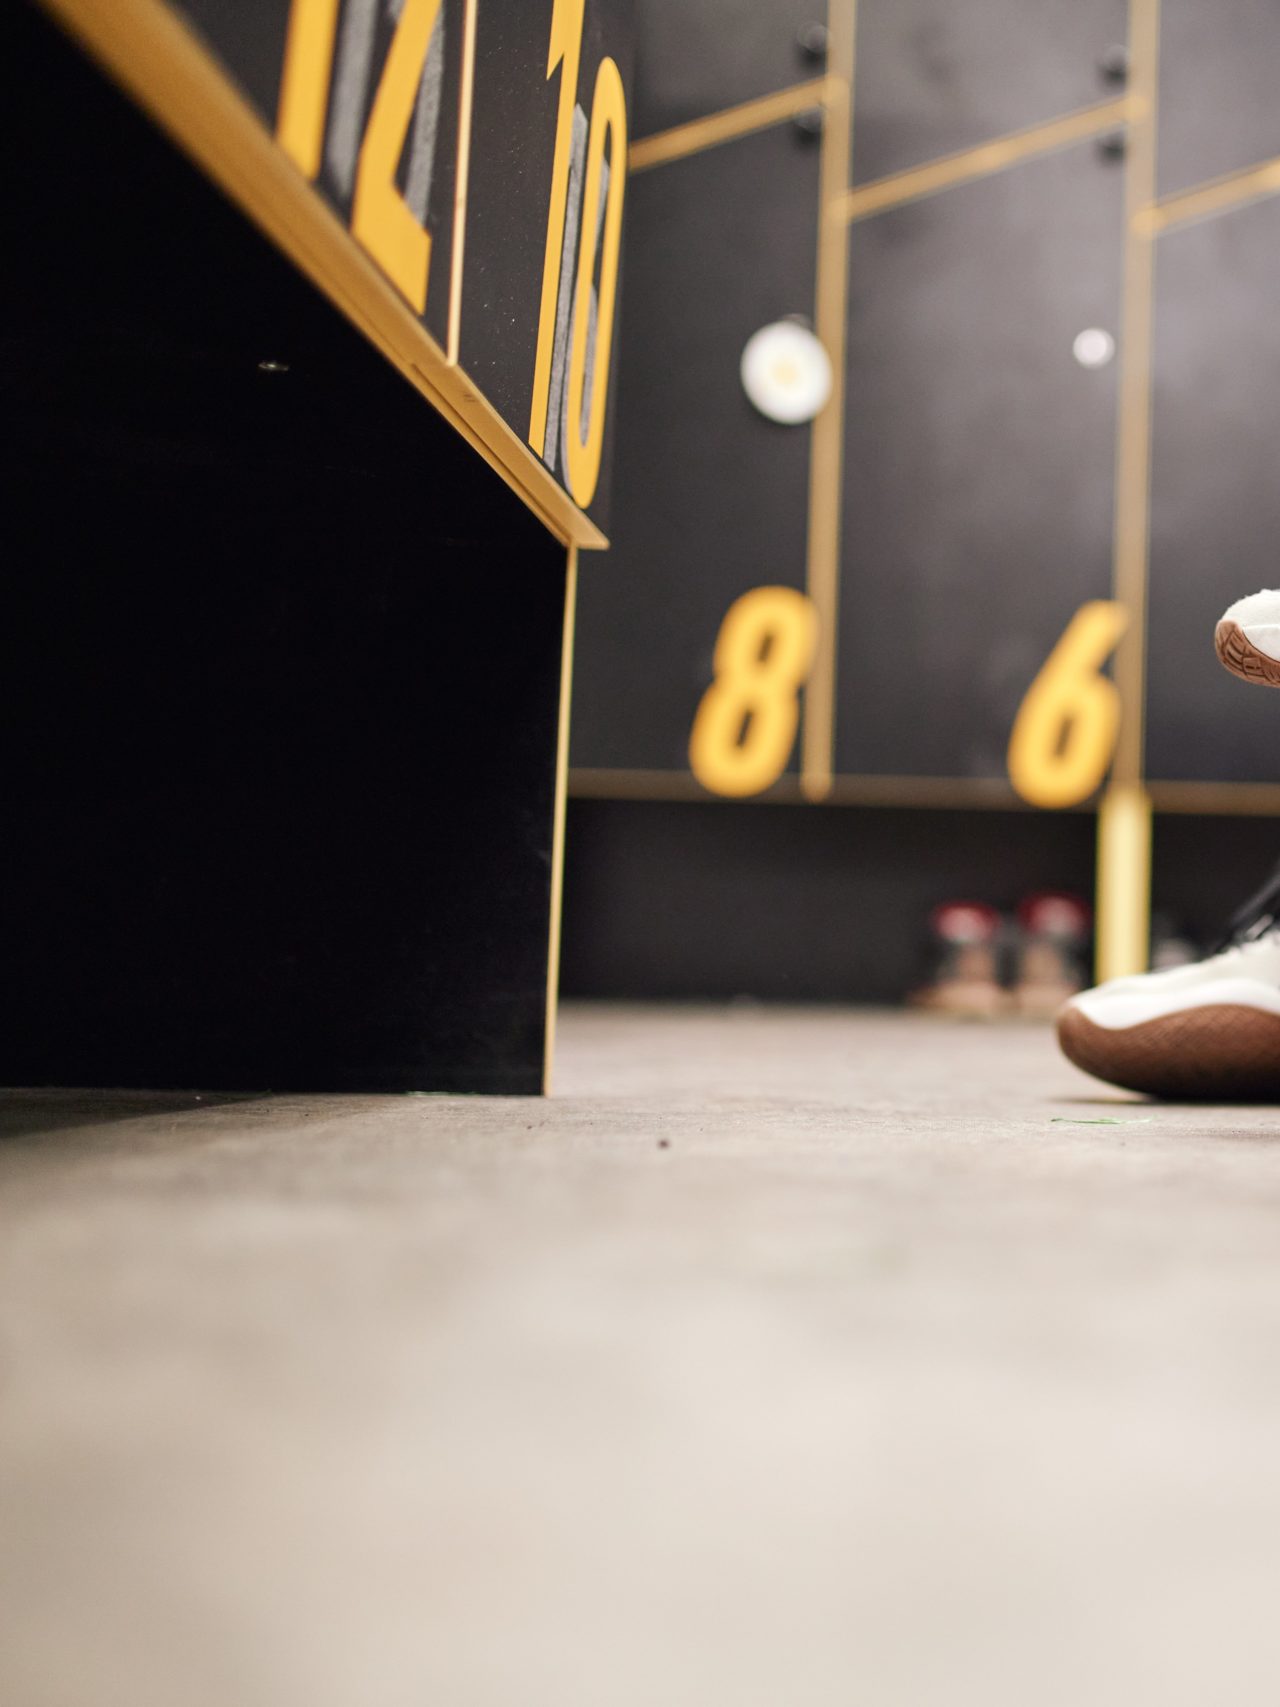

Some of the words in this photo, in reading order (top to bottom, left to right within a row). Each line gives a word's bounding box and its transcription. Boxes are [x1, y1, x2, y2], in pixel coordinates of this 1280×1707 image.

[528, 0, 626, 509] 10
[690, 587, 816, 797] 8
[1007, 600, 1125, 808] 6
